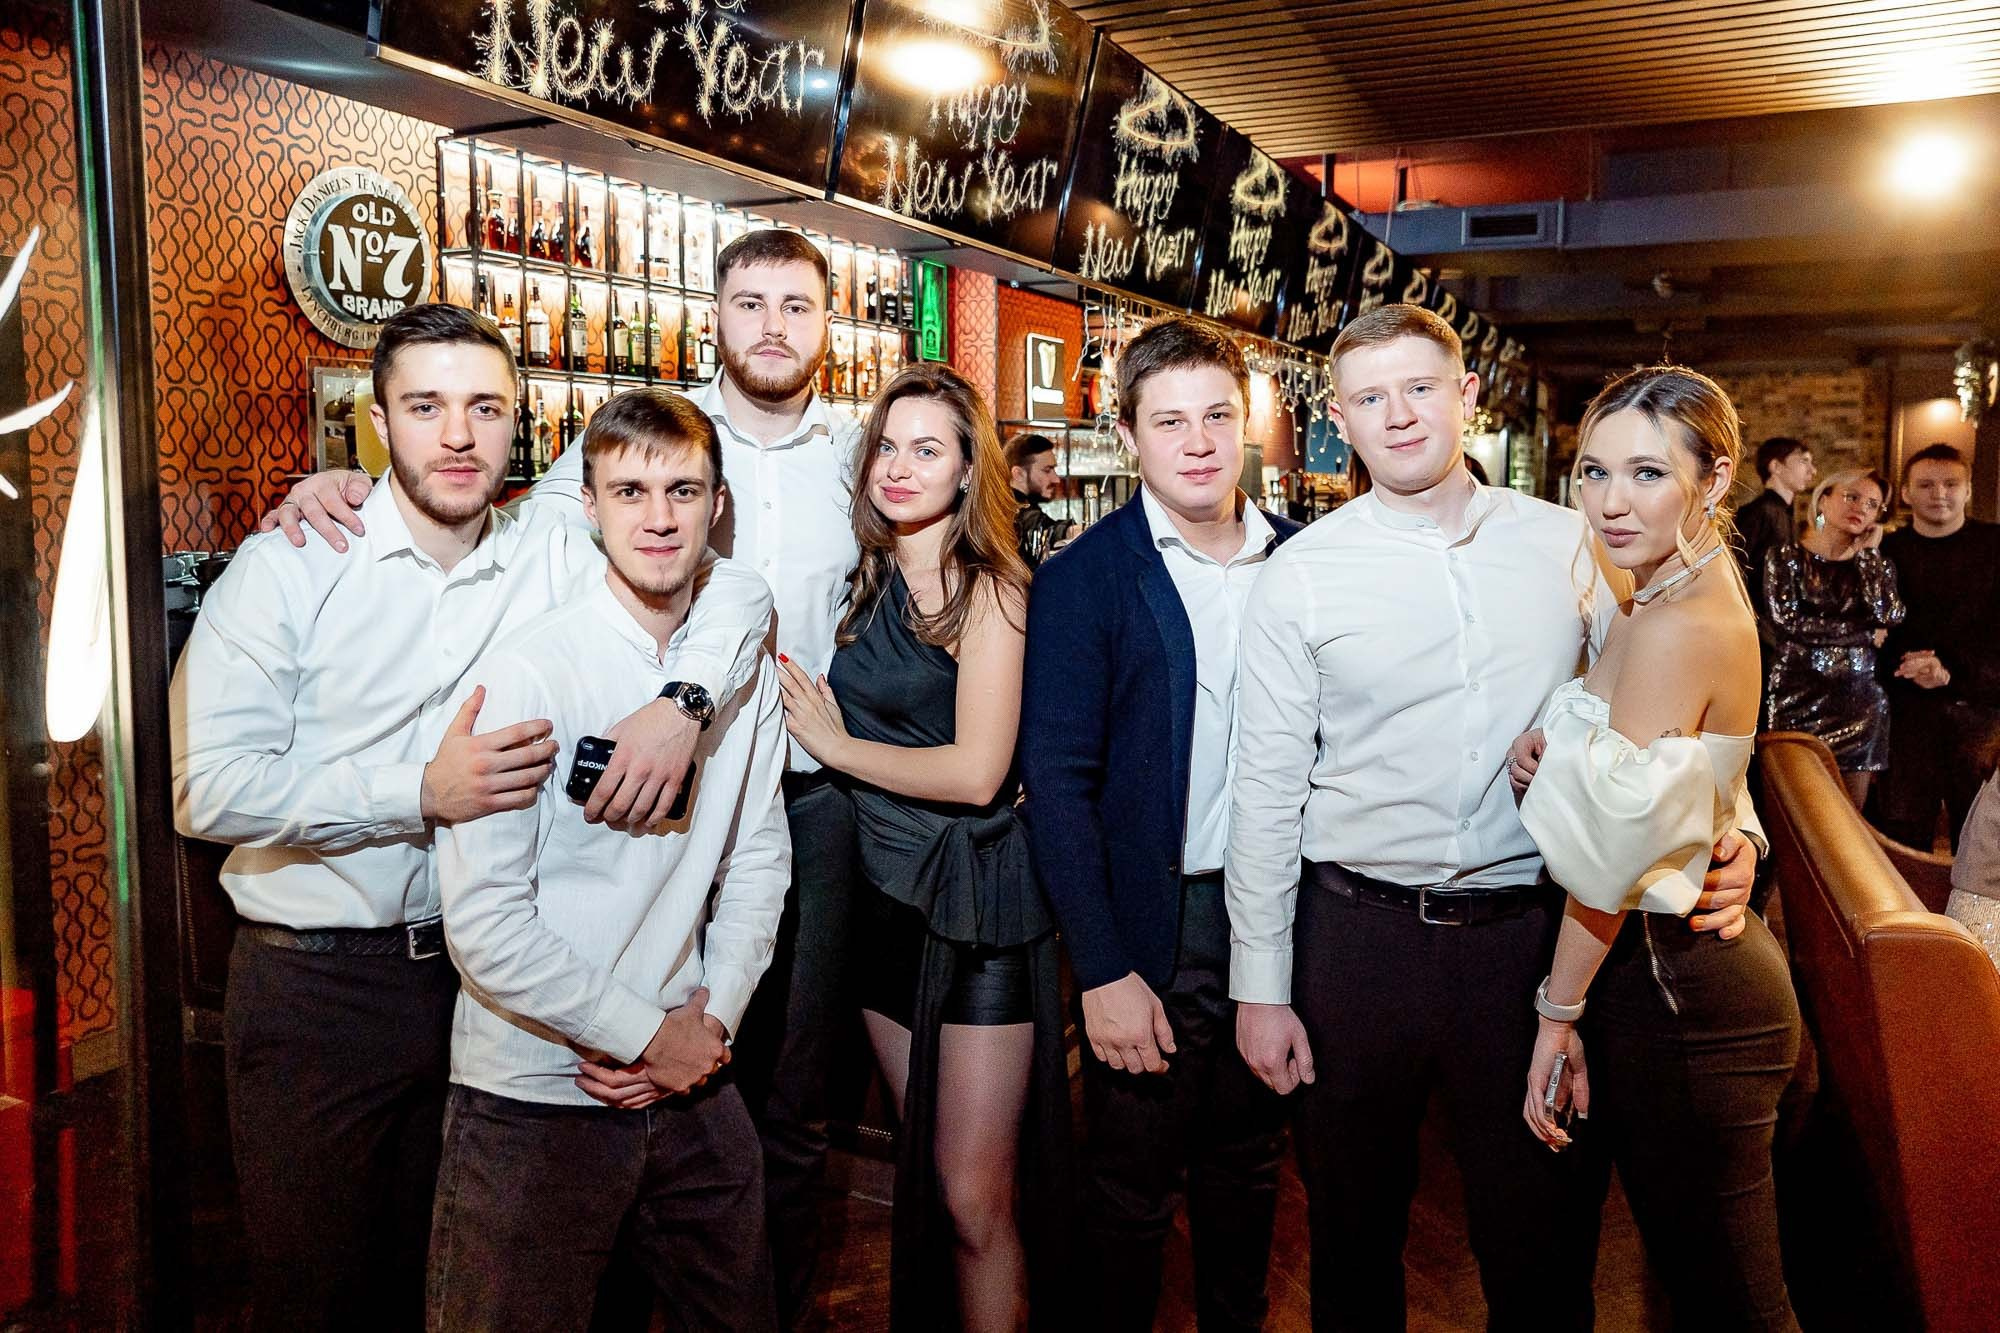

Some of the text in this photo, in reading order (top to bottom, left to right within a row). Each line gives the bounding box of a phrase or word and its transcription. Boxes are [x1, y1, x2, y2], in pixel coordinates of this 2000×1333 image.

[473, 0, 825, 126] New Year
[879, 135, 1057, 223] New Year
[1114, 154, 1178, 225] Happy
[352, 200, 397, 227] OLD
[1080, 221, 1195, 282] New Year
[342, 294, 407, 321] BRAND
